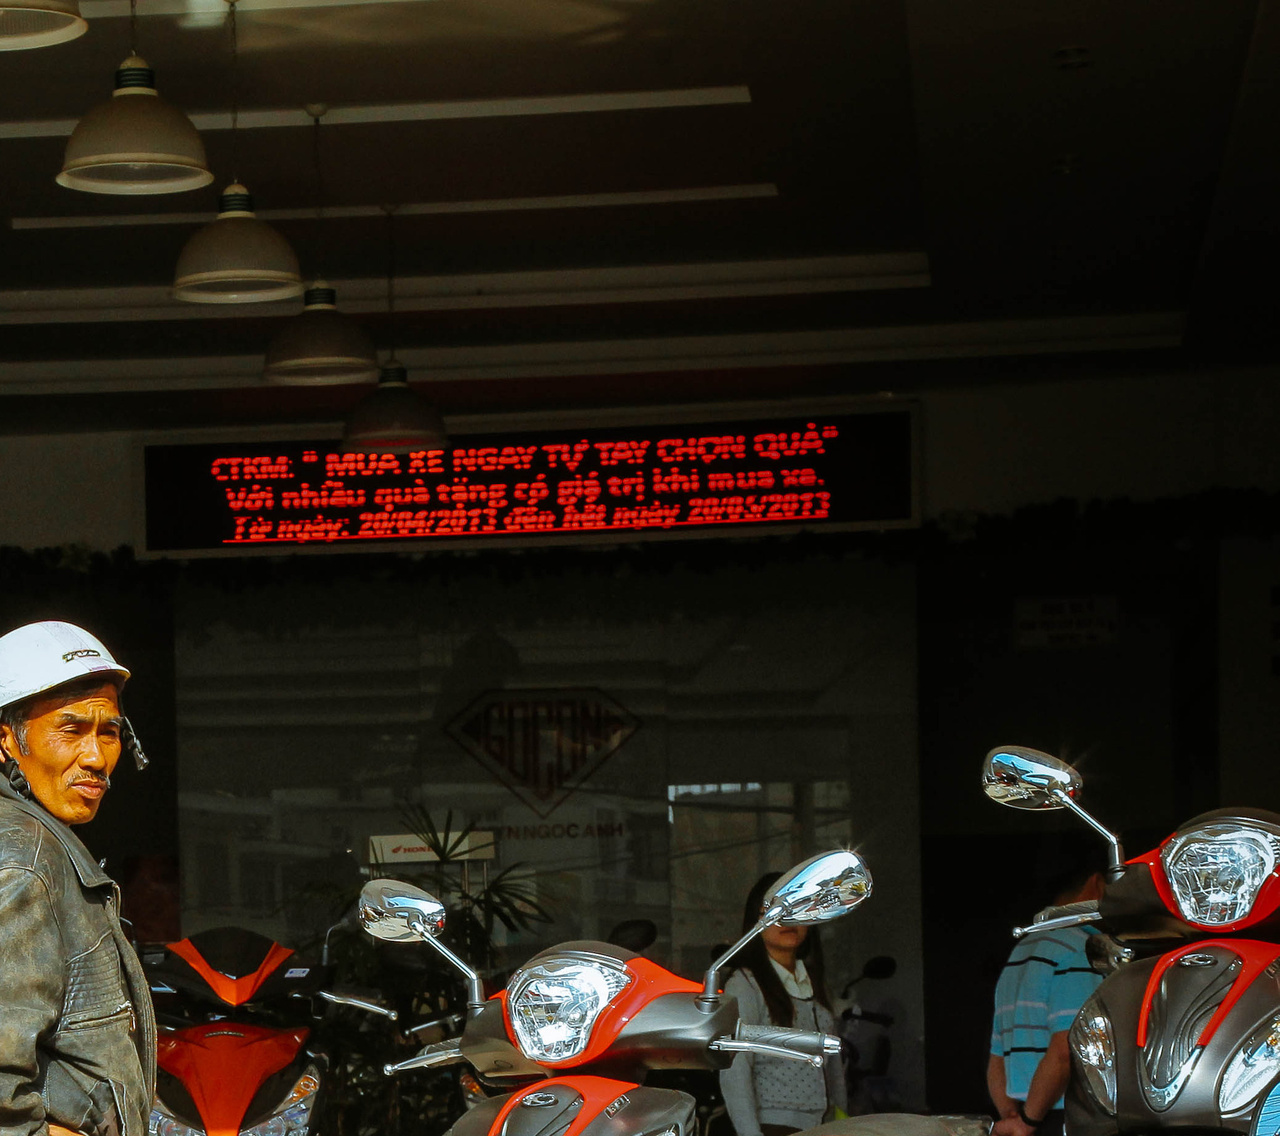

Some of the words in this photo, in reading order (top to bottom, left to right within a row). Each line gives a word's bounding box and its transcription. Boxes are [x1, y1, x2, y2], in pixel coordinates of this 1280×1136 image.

[408, 450, 445, 474] XE
[452, 446, 538, 473] NGAY
[593, 440, 651, 467] TAY
[656, 434, 747, 464] CHỌN
[652, 467, 700, 493] khi
[707, 470, 776, 490] mua
